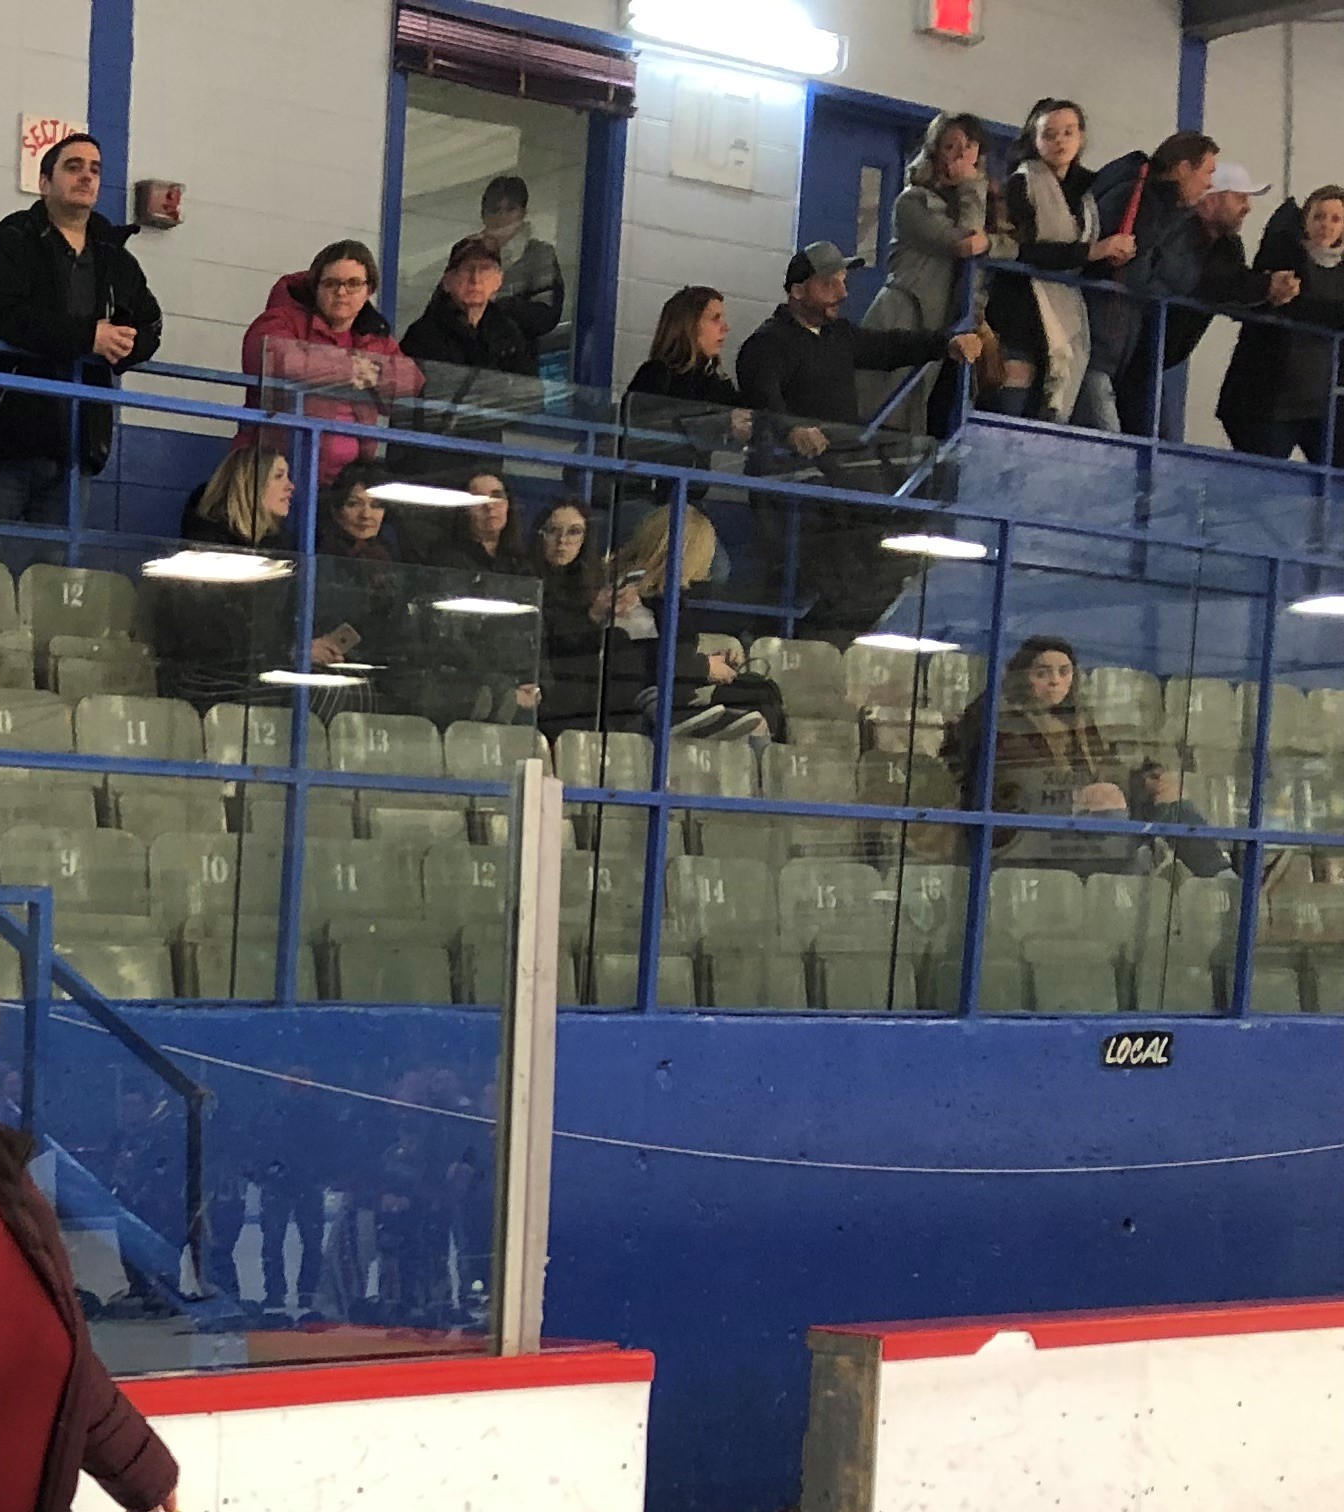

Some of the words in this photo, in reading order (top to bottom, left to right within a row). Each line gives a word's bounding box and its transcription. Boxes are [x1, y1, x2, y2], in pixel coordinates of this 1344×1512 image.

[22, 120, 76, 156] SECTI
[63, 582, 84, 606] 12
[126, 721, 146, 746] 11
[252, 721, 276, 746] 12
[60, 849, 79, 877] 9
[202, 854, 228, 884] 10
[472, 860, 496, 887] 12
[336, 864, 358, 890] 11
[1105, 1036, 1169, 1064] LOCAL
